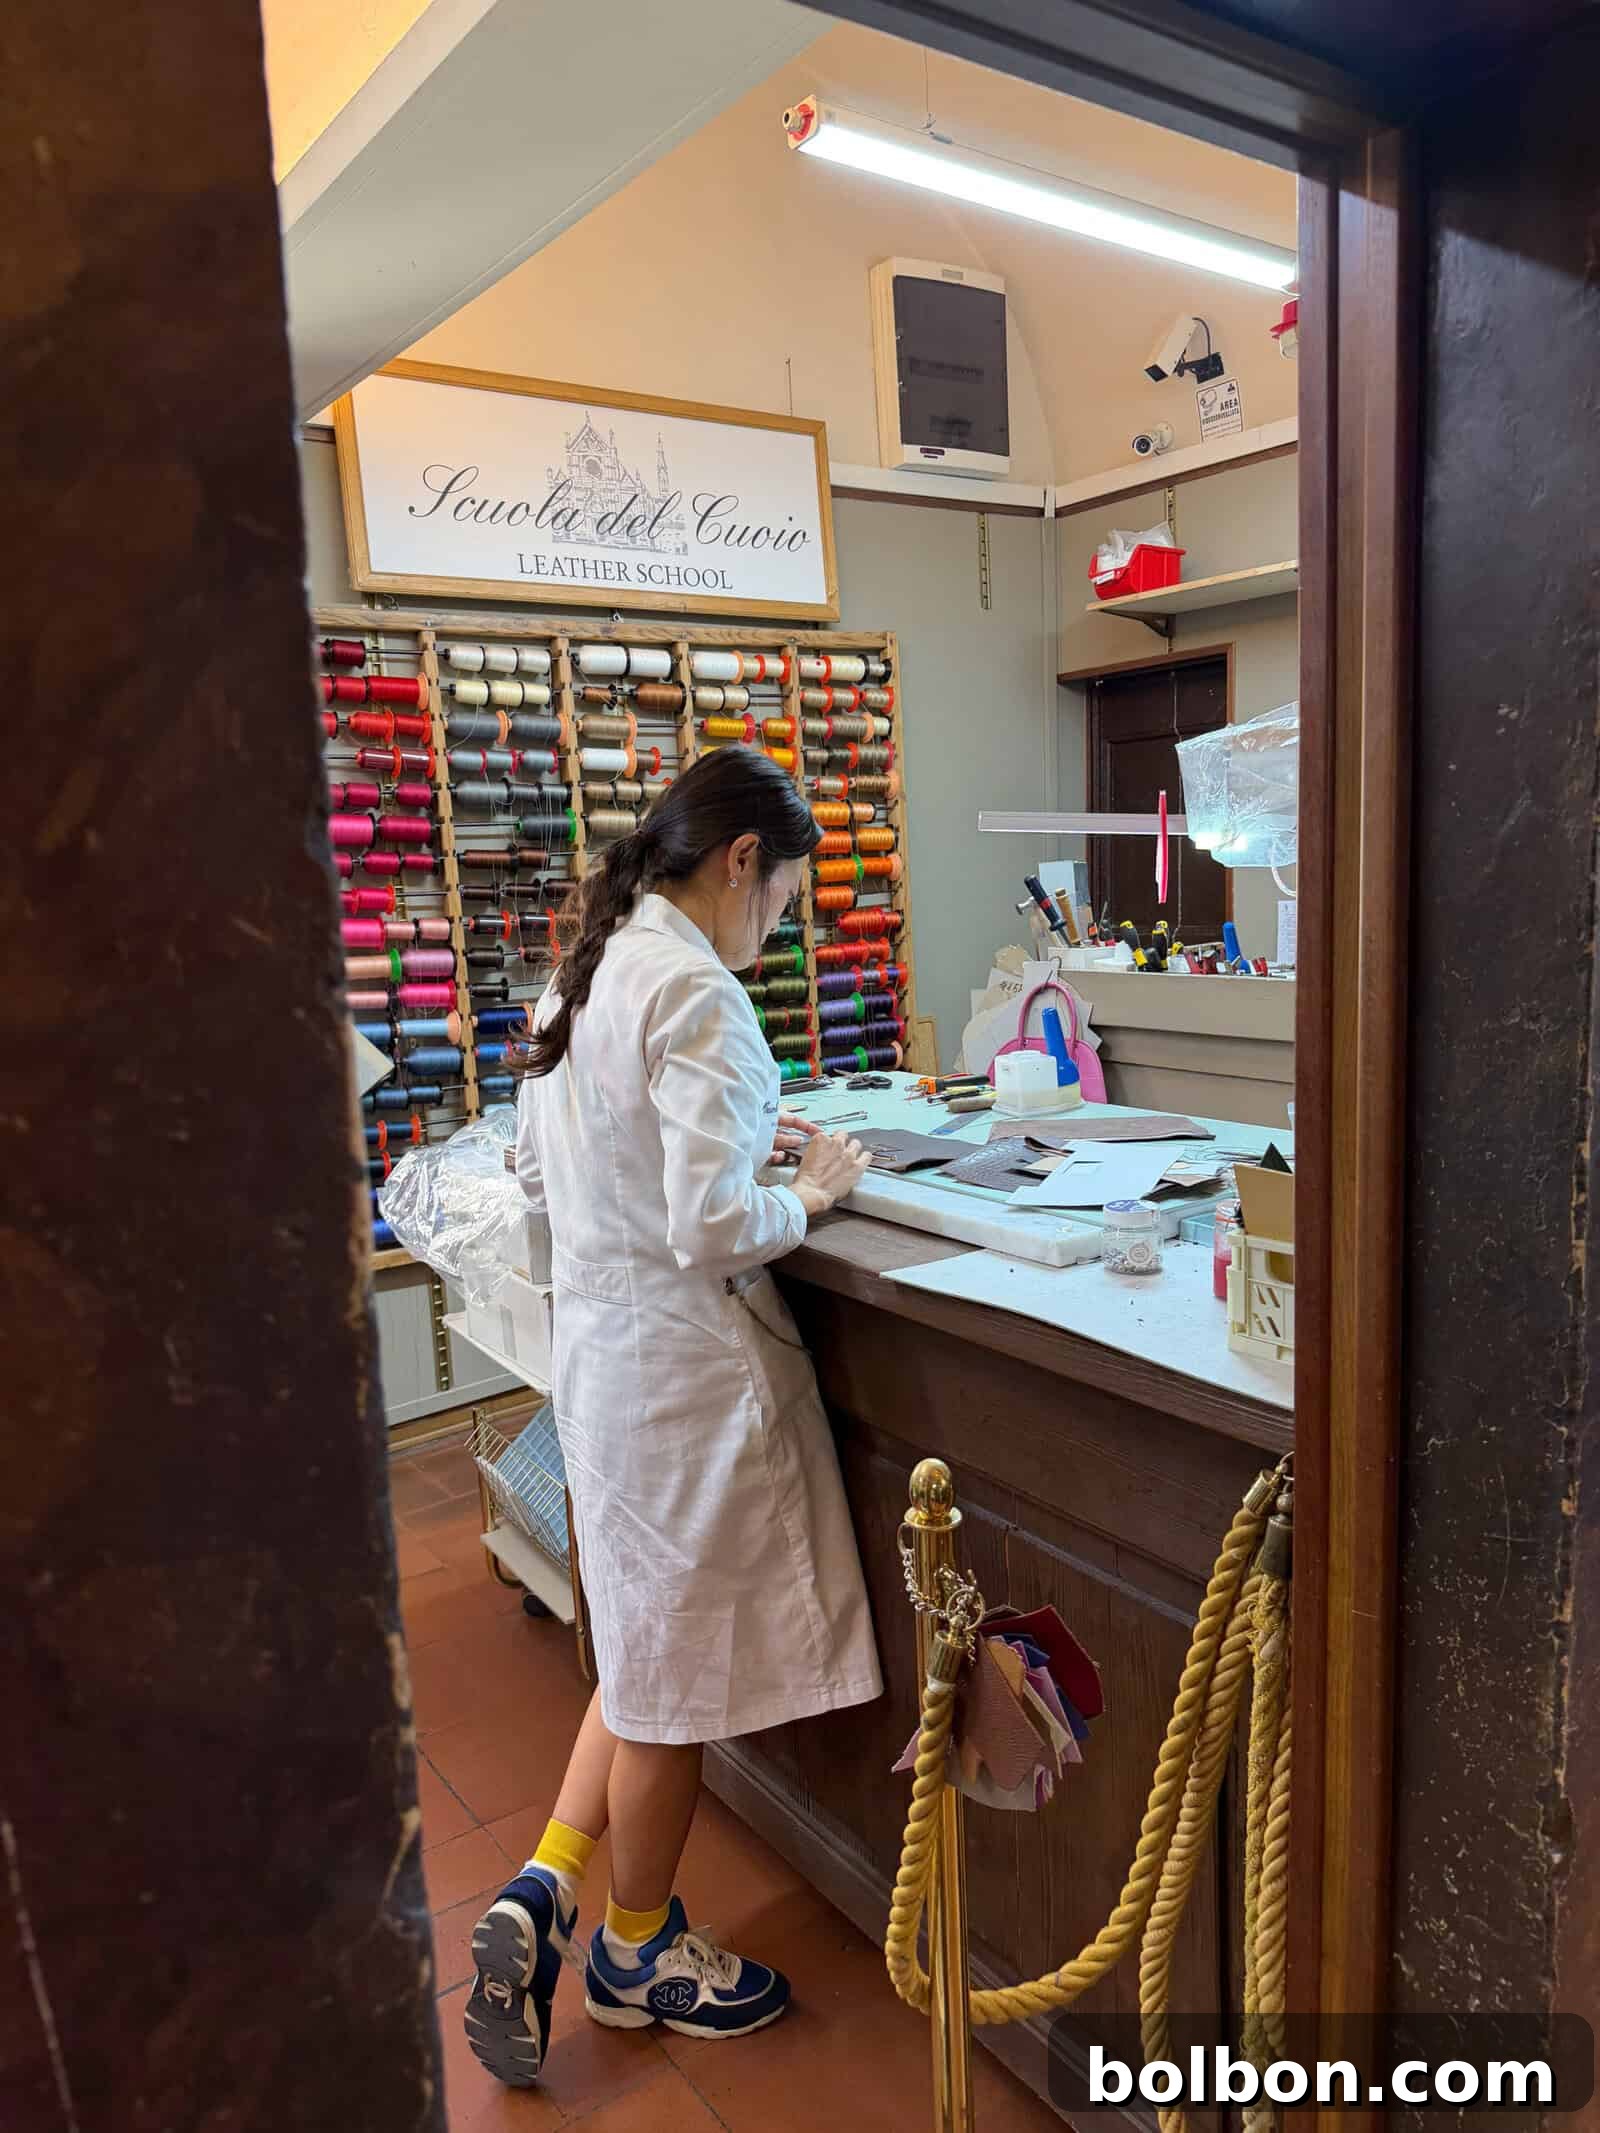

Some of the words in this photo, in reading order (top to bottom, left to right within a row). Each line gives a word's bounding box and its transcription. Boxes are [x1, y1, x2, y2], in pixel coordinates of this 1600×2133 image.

[1220, 398, 1238, 411] AREA
[408, 463, 584, 533] Scuola
[595, 490, 682, 540] del
[692, 492, 811, 553] Cuoio
[517, 553, 632, 584] LEATHER
[636, 563, 733, 590] SCHOOL
